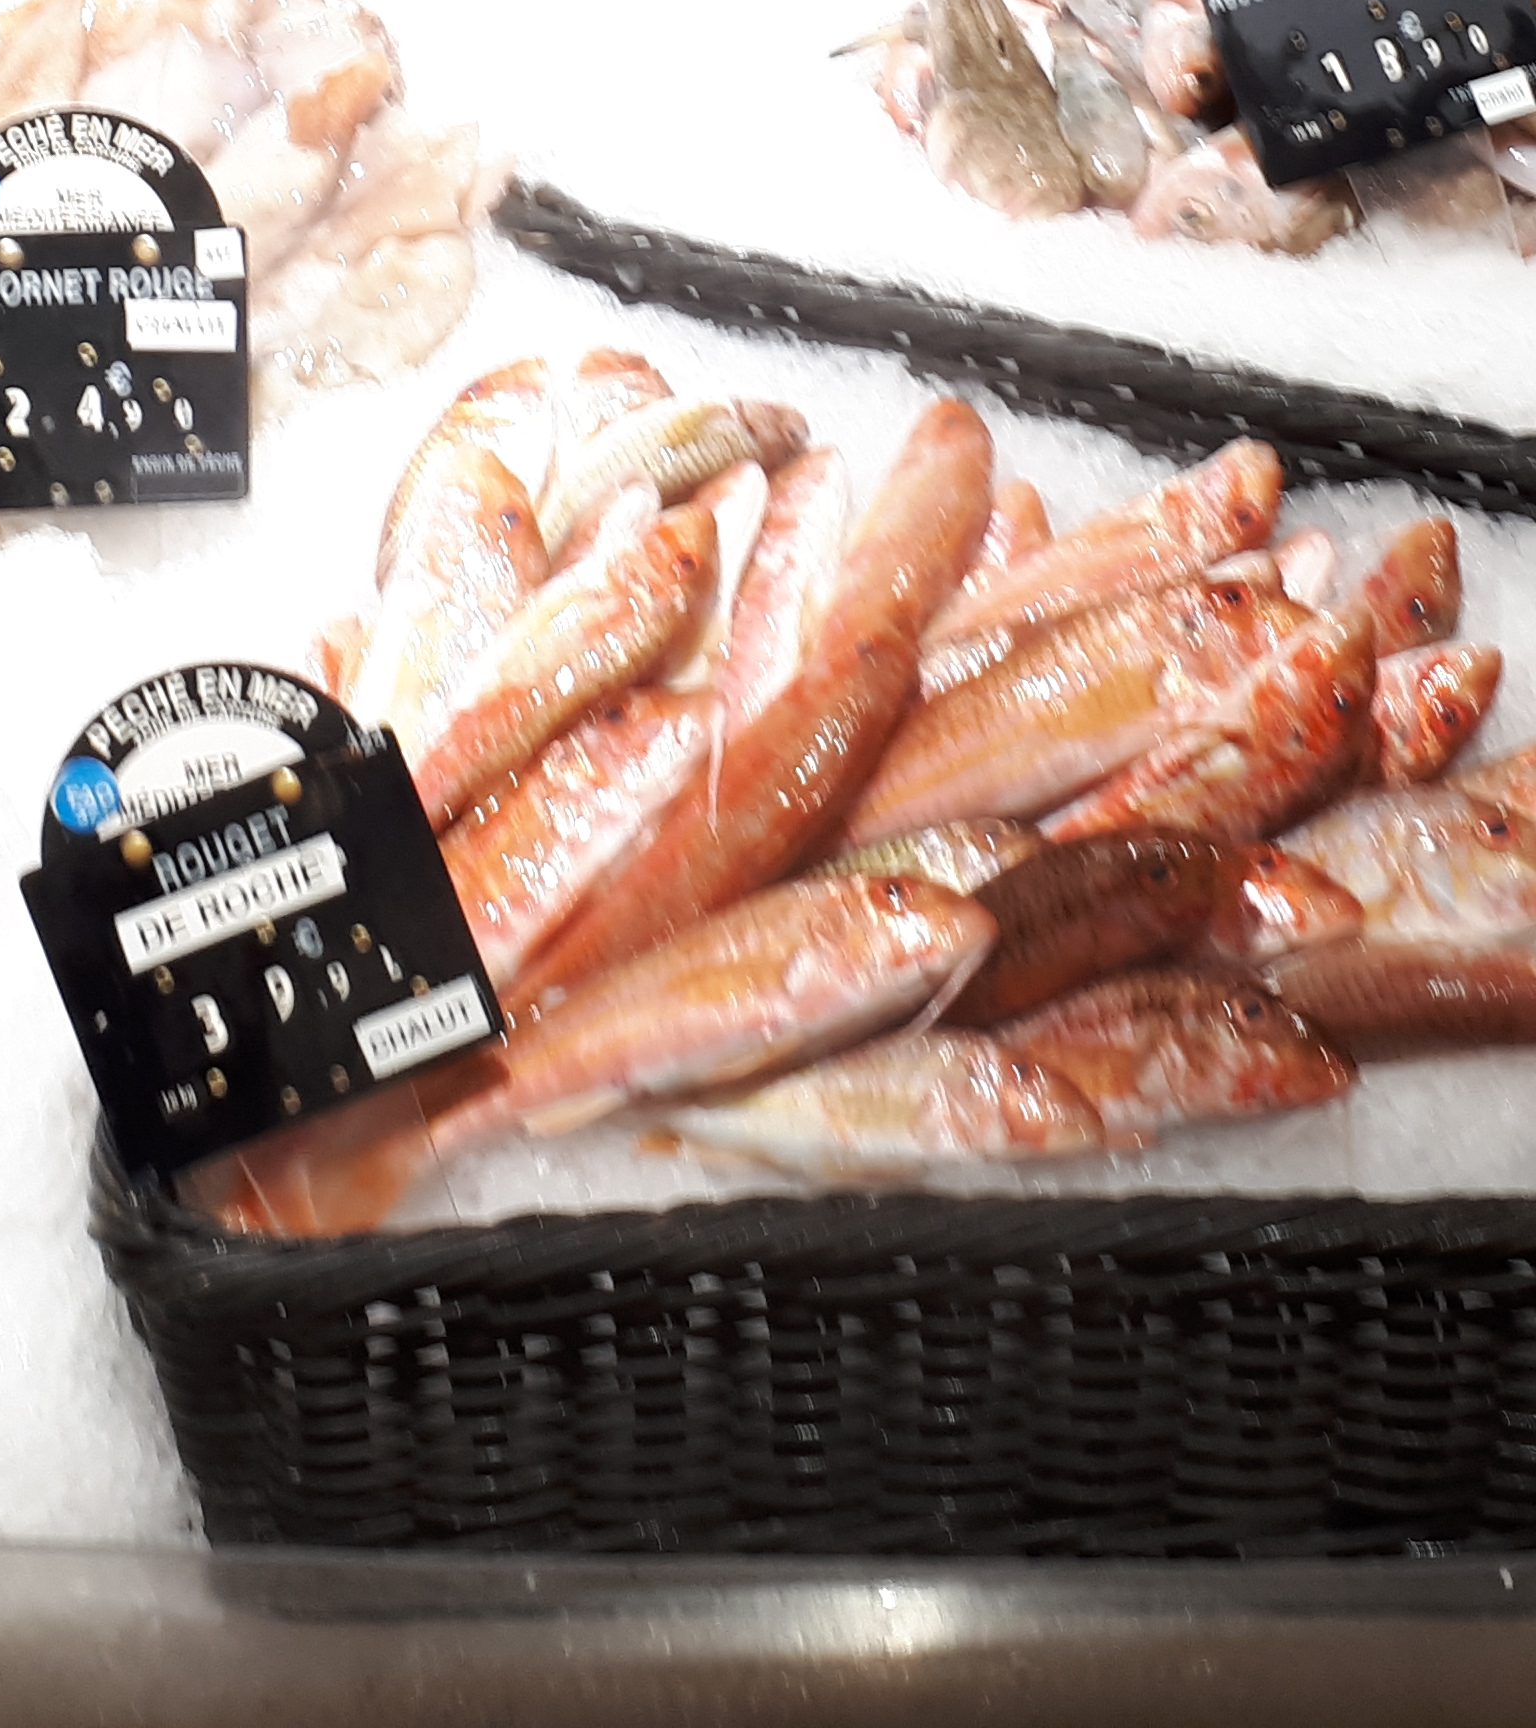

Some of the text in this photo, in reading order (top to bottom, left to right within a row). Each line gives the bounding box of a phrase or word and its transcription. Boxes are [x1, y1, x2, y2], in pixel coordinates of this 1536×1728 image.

[71, 113, 113, 143] EN
[113, 122, 175, 178] MER
[56, 188, 103, 209] MER
[108, 265, 215, 302] ROUGE
[196, 666, 243, 703] EN
[182, 751, 243, 786] MER
[152, 805, 292, 895] ROUGET
[134, 851, 325, 955] DE ROCHE
